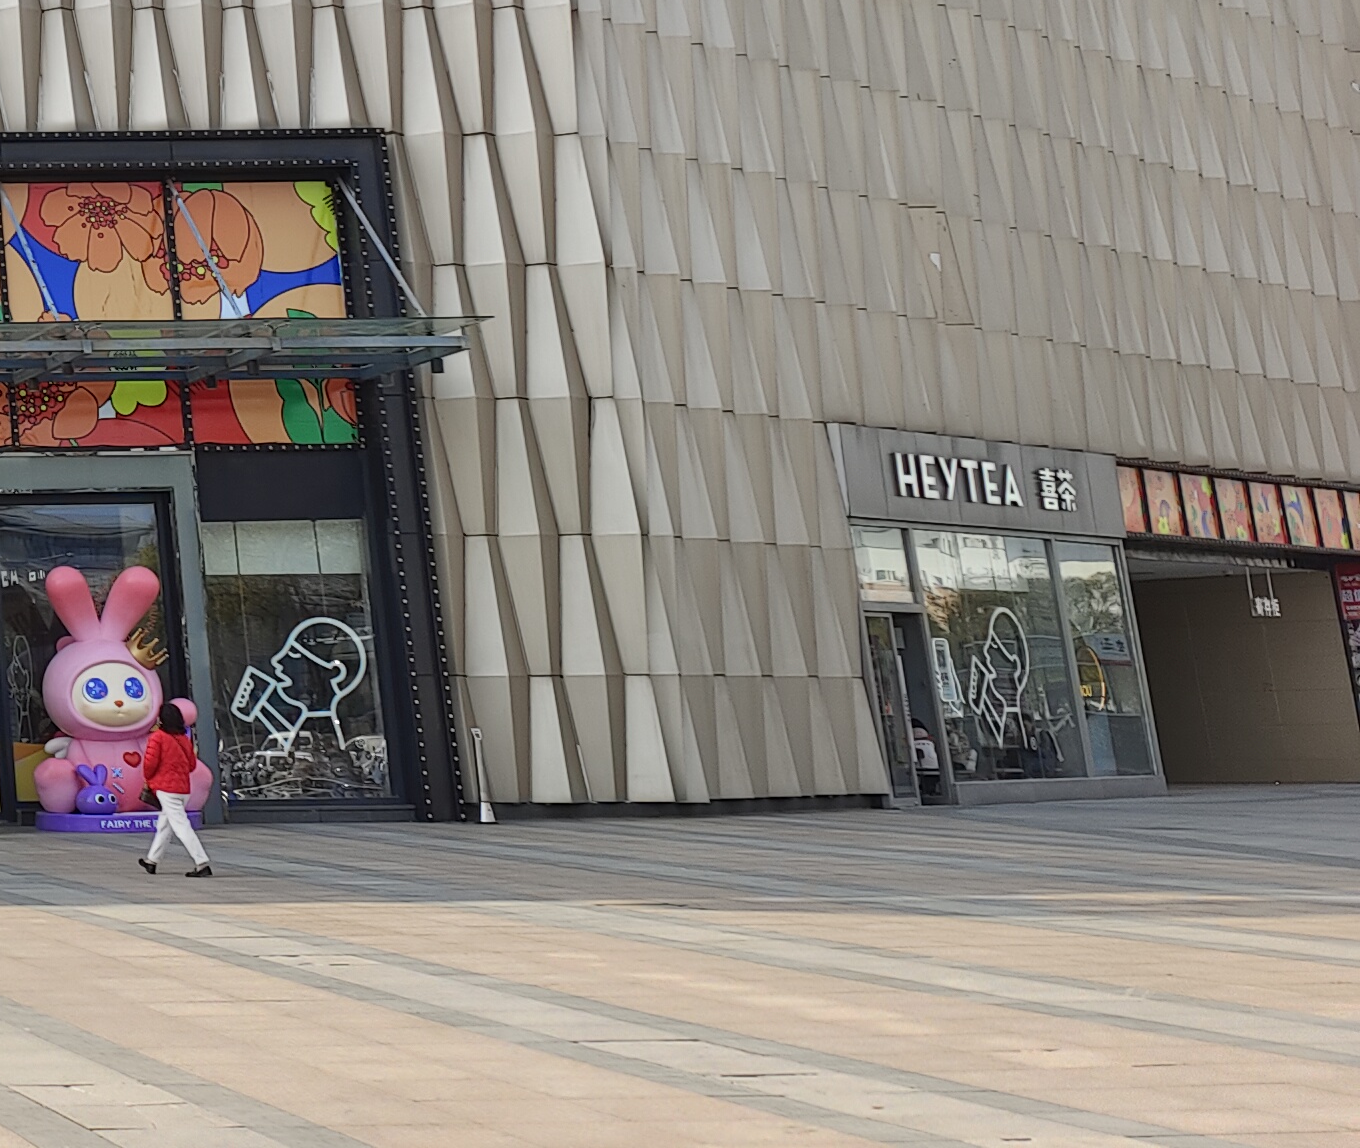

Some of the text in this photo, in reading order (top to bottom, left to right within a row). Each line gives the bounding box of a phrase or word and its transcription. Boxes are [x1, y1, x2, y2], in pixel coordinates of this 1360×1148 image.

[890, 452, 1078, 512] HEYTEA 喜茶
[100, 819, 131, 829] FAIRY
[133, 819, 152, 828] THE
